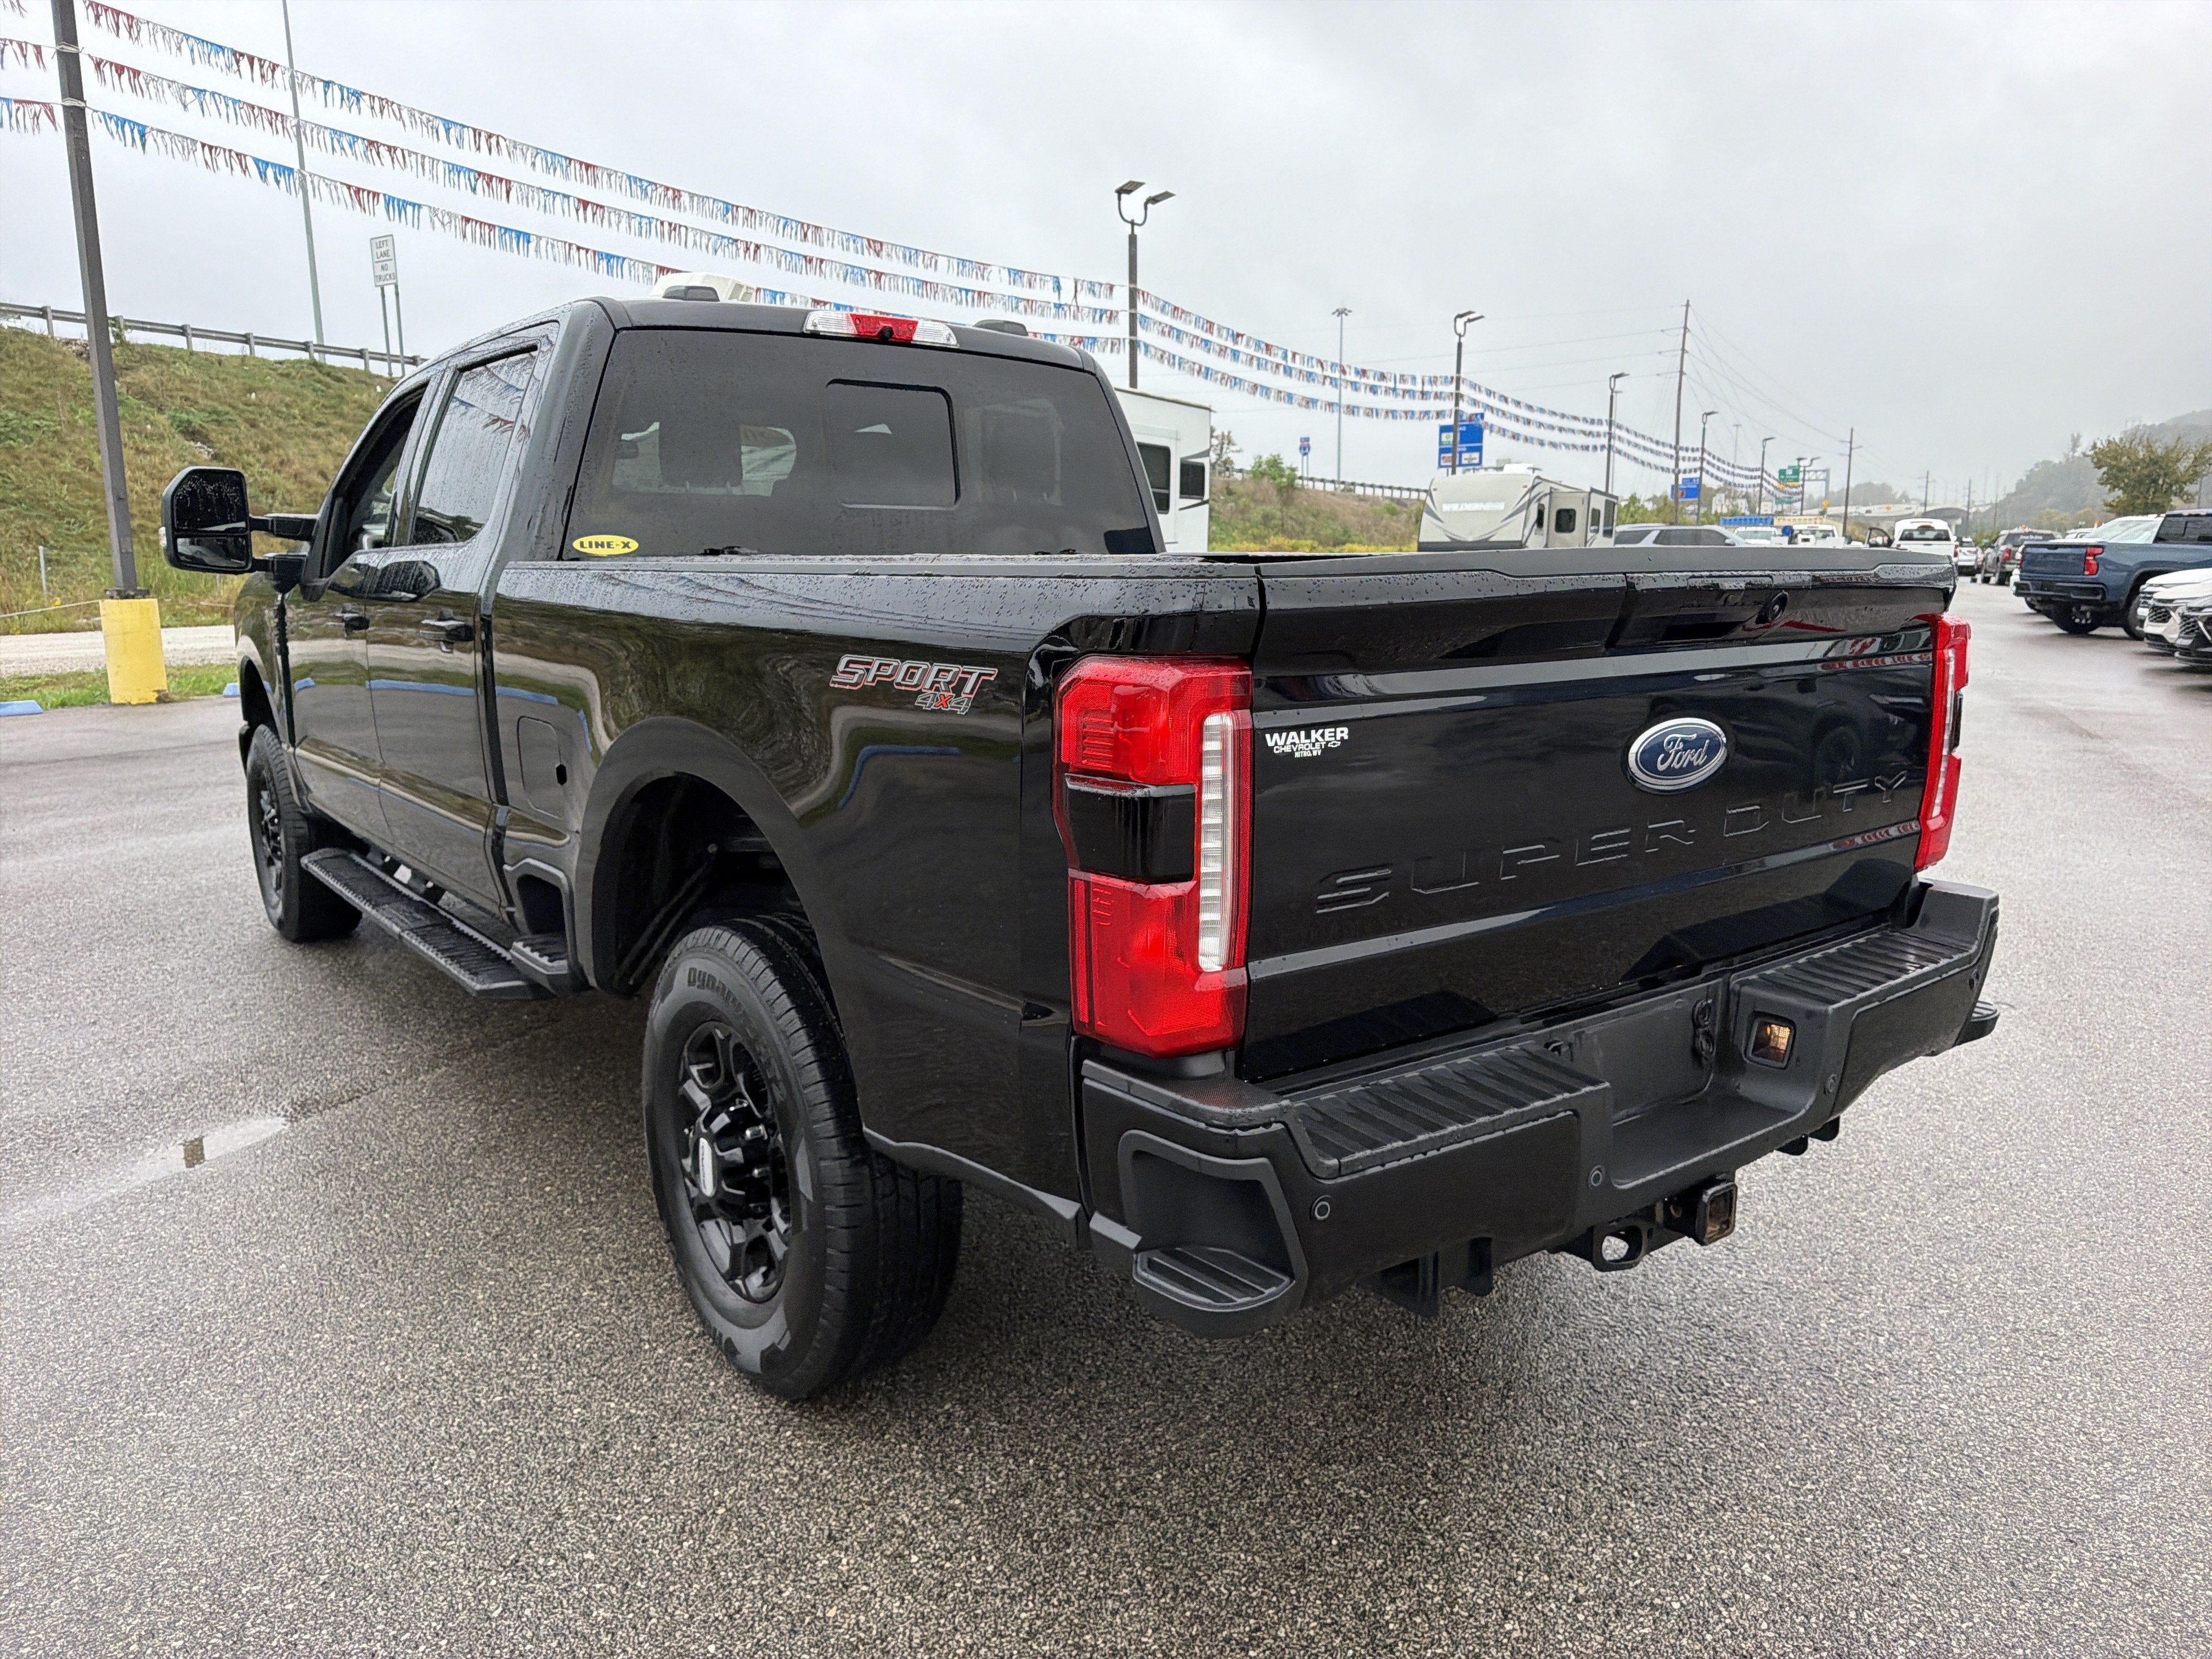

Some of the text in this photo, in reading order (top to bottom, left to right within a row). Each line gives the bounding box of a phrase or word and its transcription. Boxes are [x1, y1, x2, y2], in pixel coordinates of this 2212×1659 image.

[375, 239, 388, 249] LEFT
[375, 249, 390, 259] LANE
[381, 263, 388, 272] NO
[375, 272, 396, 282] TRUCKS
[579, 540, 632, 549] LINE-X
[829, 654, 998, 697] SPORT
[1265, 727, 1348, 747] WALKER
[1273, 741, 1326, 754] CHEVROLET
[1657, 733, 1710, 771] Ford
[1314, 769, 1908, 915] SUPER DUTY
